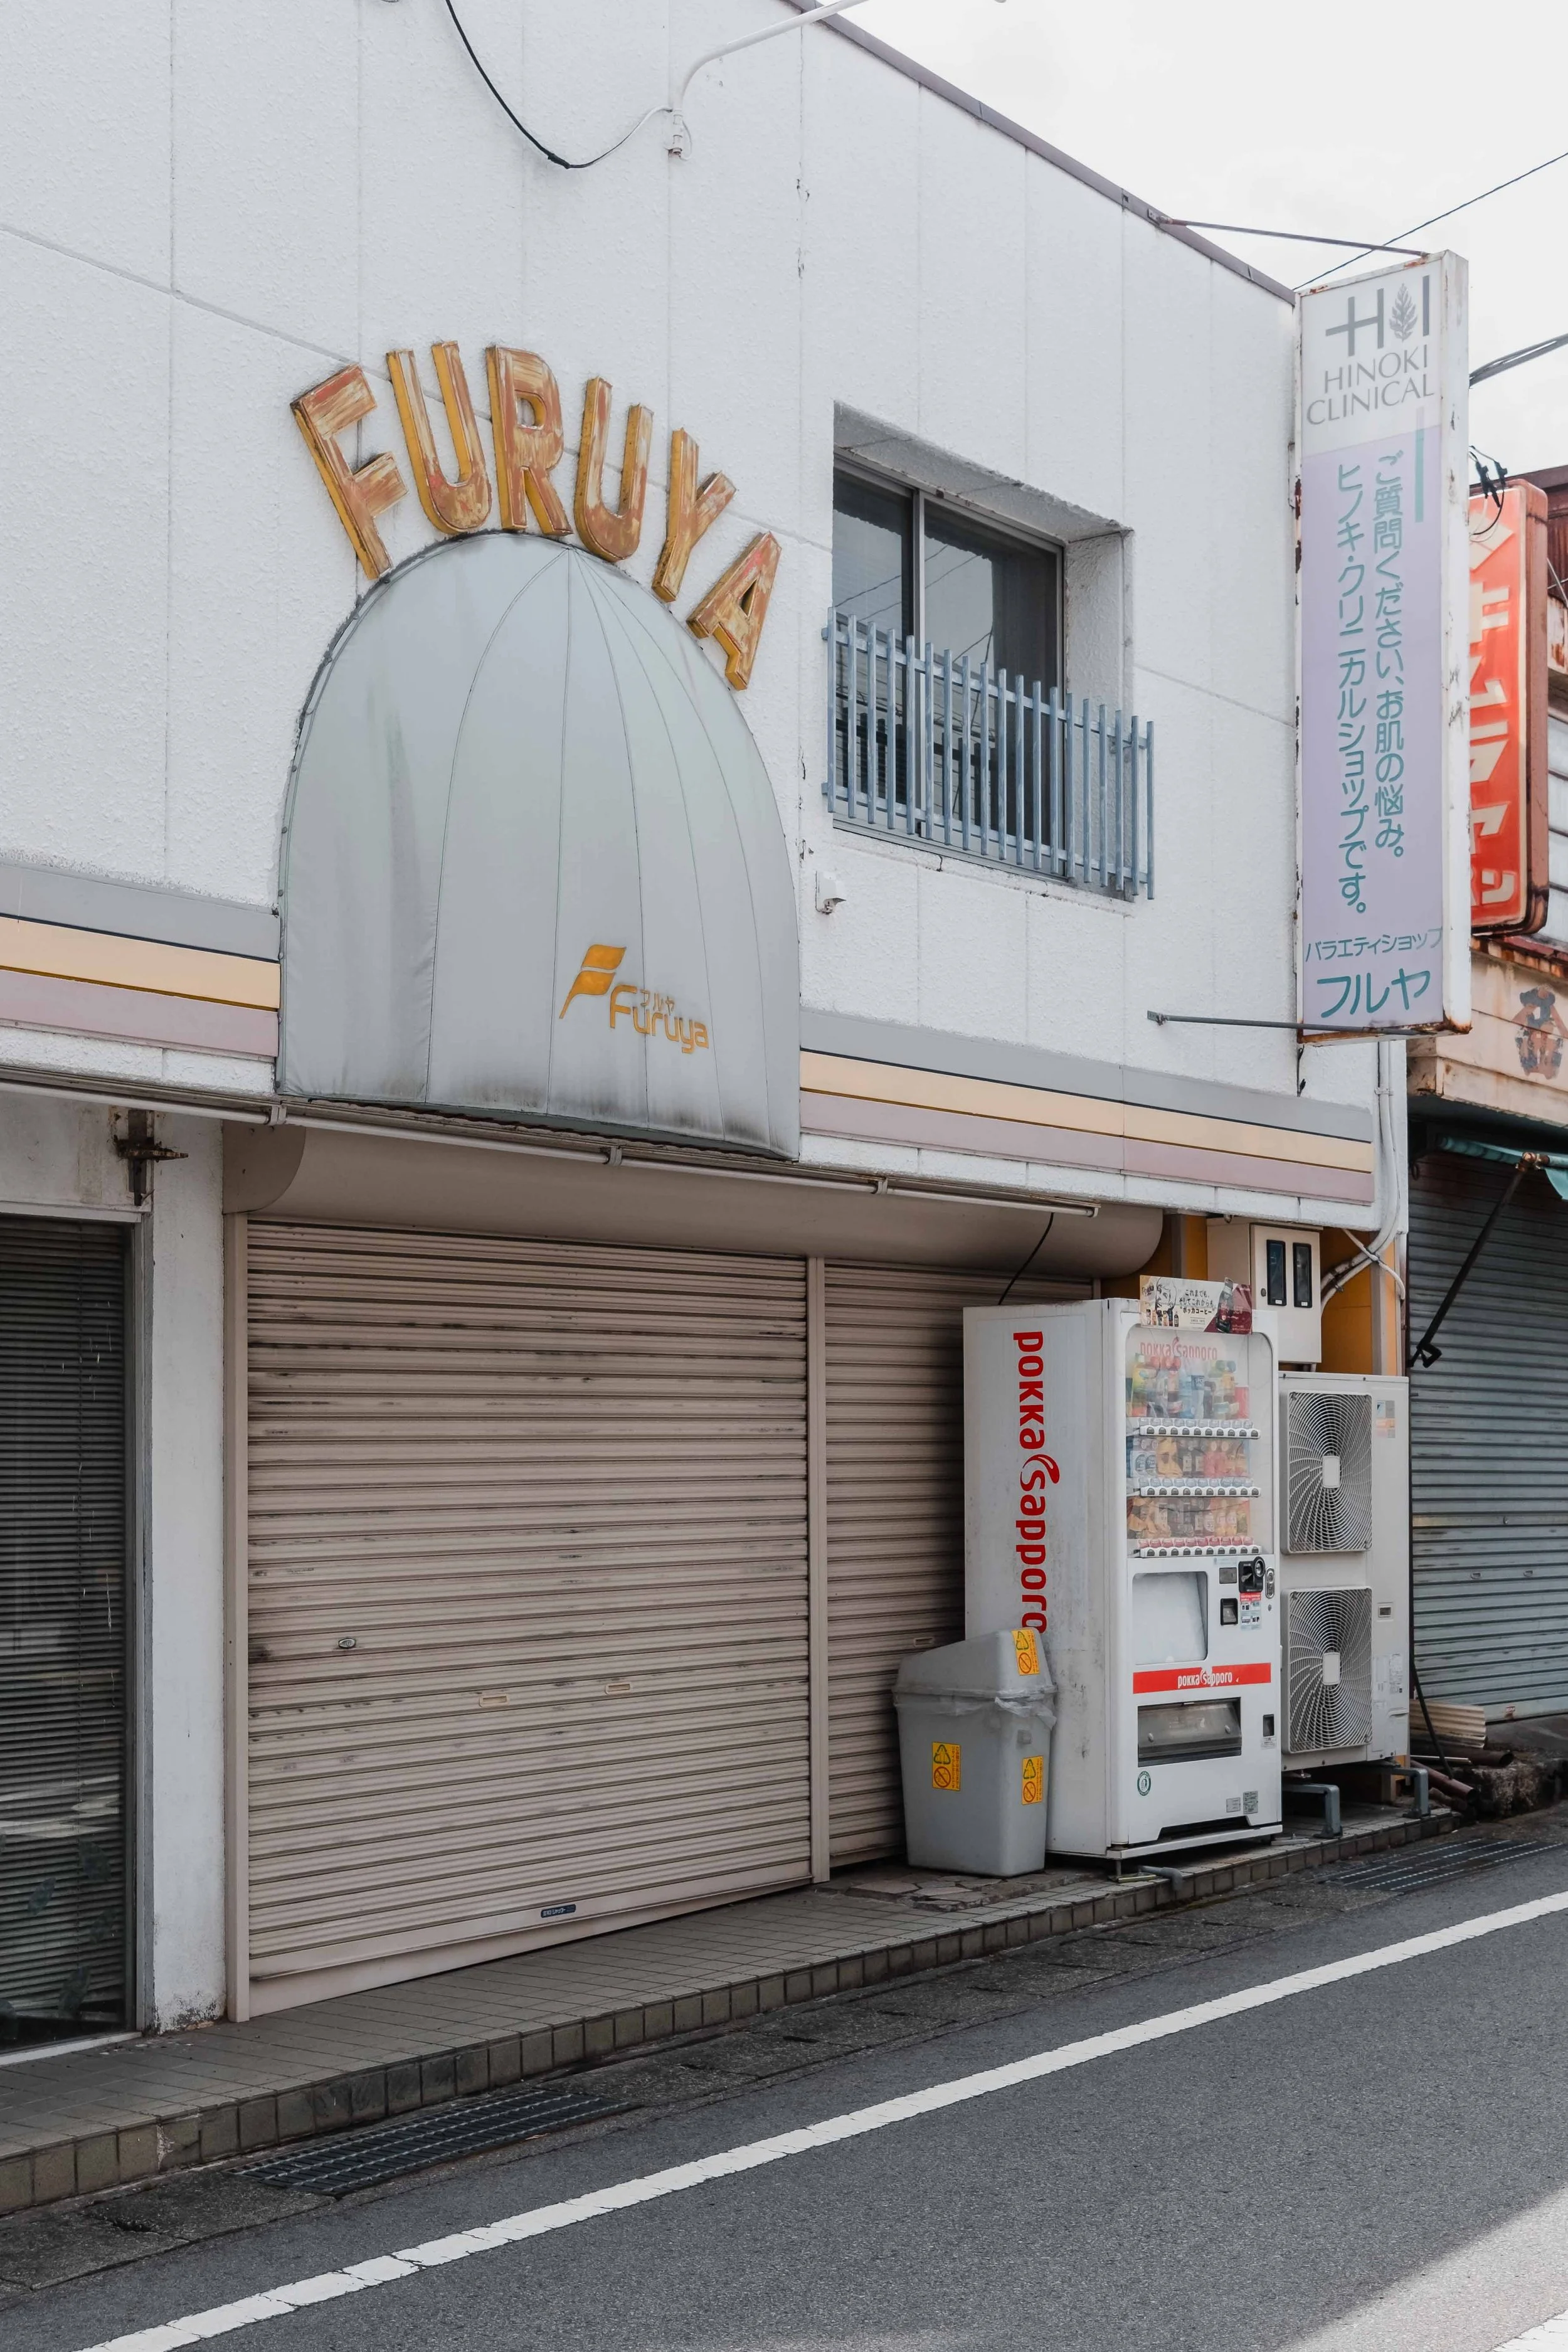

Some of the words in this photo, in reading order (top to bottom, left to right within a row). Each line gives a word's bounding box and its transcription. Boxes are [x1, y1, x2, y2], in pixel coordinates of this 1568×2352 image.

[1306, 373, 1434, 426] CLINICAL
[1324, 344, 1428, 395] HINOKI
[290, 340, 782, 691] FURUYA
[1373, 450, 1405, 858] ご質問ください、お肌の悩み。
[610, 984, 709, 1054] Furuya
[1316, 968, 1431, 1018] フルヤ
